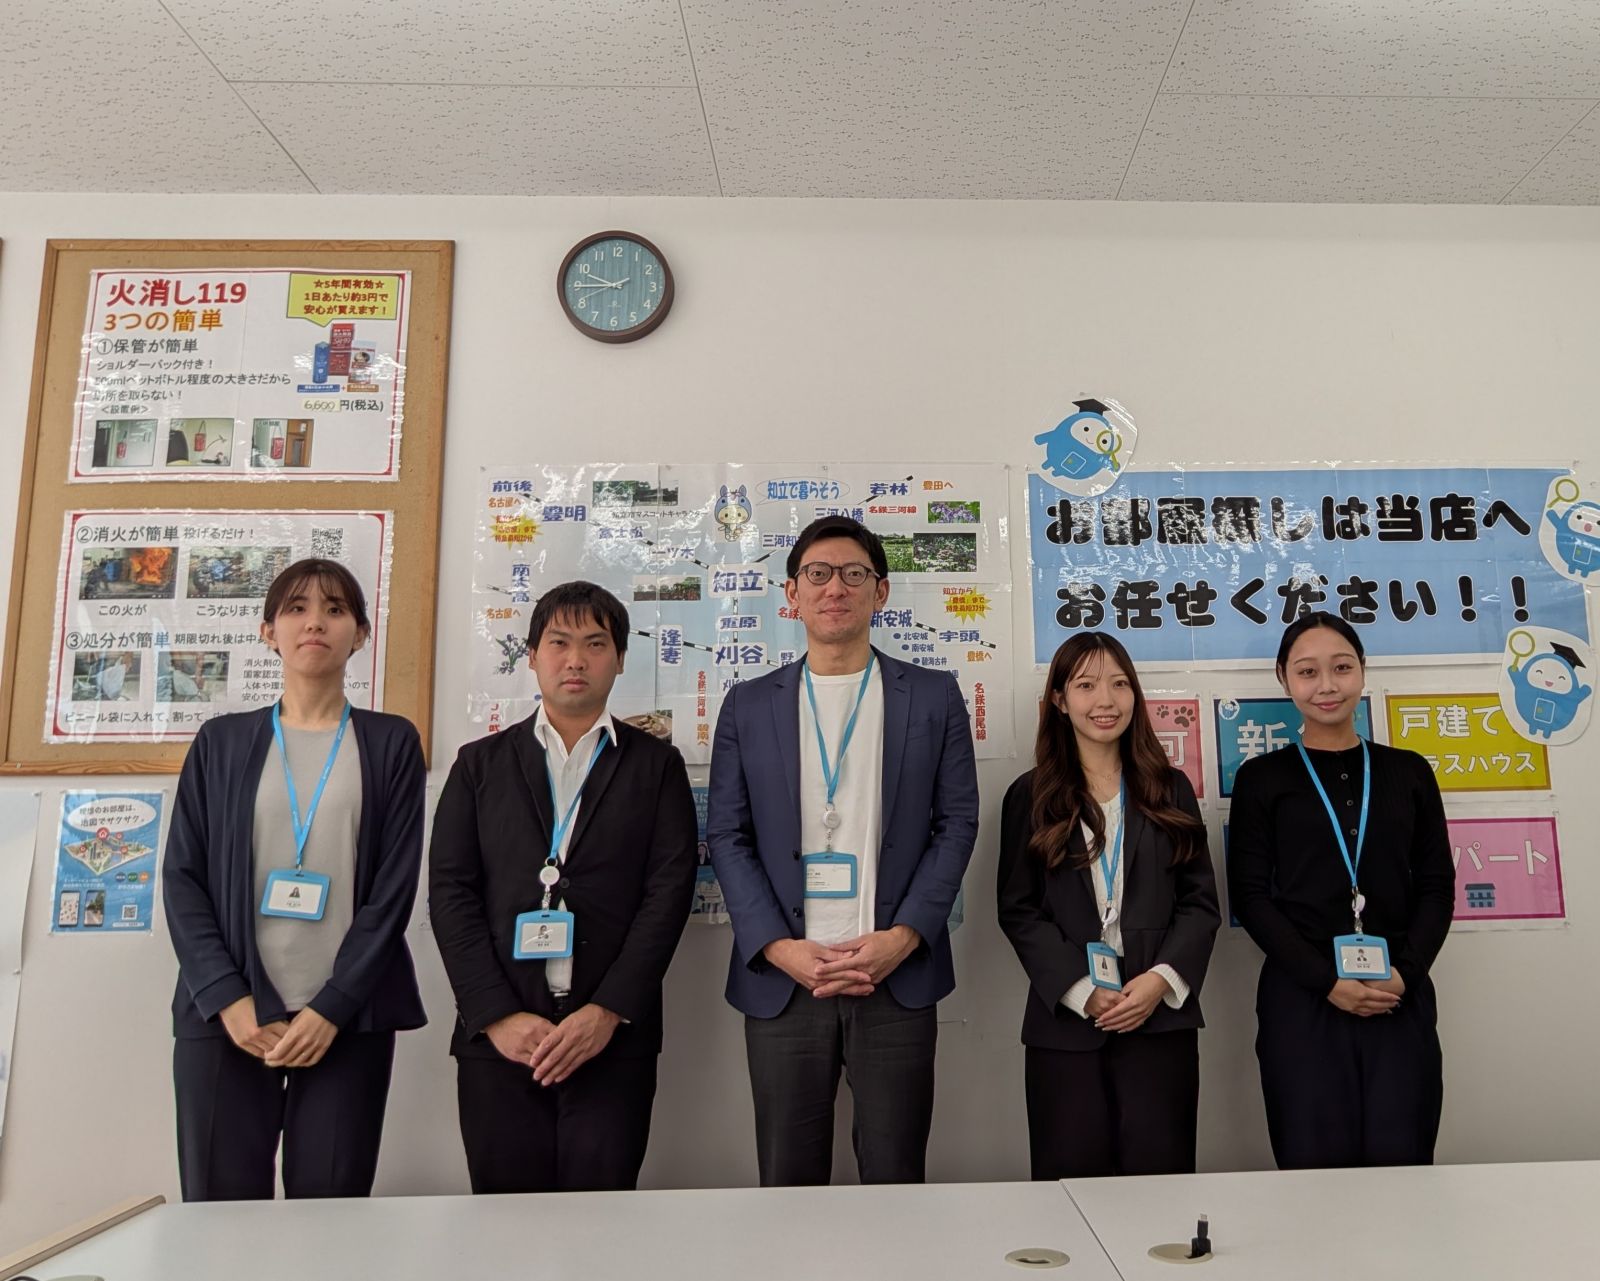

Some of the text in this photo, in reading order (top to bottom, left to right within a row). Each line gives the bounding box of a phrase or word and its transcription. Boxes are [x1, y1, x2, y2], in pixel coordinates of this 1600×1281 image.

[595, 251, 604, 261] 11
[612, 246, 623, 257] 12
[635, 251, 639, 262] 1
[579, 263, 590, 274] 10
[645, 264, 653, 275] 2
[649, 281, 657, 292] 3
[106, 278, 247, 307] 火消し119
[304, 292, 388, 302] 1日あたり約3円で
[577, 298, 586, 309] 8
[643, 299, 651, 310] 4
[104, 308, 223, 332] 3つの簡単
[592, 311, 599, 321] 7
[610, 316, 618, 327] 6
[629, 311, 637, 322] 5
[96, 338, 200, 355] ①保管が簡単
[492, 480, 534, 492] 前後
[767, 480, 840, 500] 知立で暮らそう
[869, 482, 909, 496] 若林
[922, 480, 954, 491] 豊田へ
[488, 497, 522, 508] 名古屋へ
[868, 506, 917, 514] 名鉄三河線
[76, 525, 180, 543] ②消火が簡単
[763, 534, 800, 548] 三河知
[713, 570, 764, 593] 知立
[98, 603, 148, 617] この火が
[486, 608, 521, 619] 名古屋へ
[778, 606, 804, 620] 名鉄
[65, 631, 171, 650] ③処分が簡単
[903, 632, 929, 641] 北安城
[660, 629, 682, 665] 逢妻
[911, 643, 935, 653] 南安城
[715, 645, 764, 665] 刈谷
[974, 682, 987, 741] 名鉄西尾線
[1398, 703, 1503, 739] 戸建て
